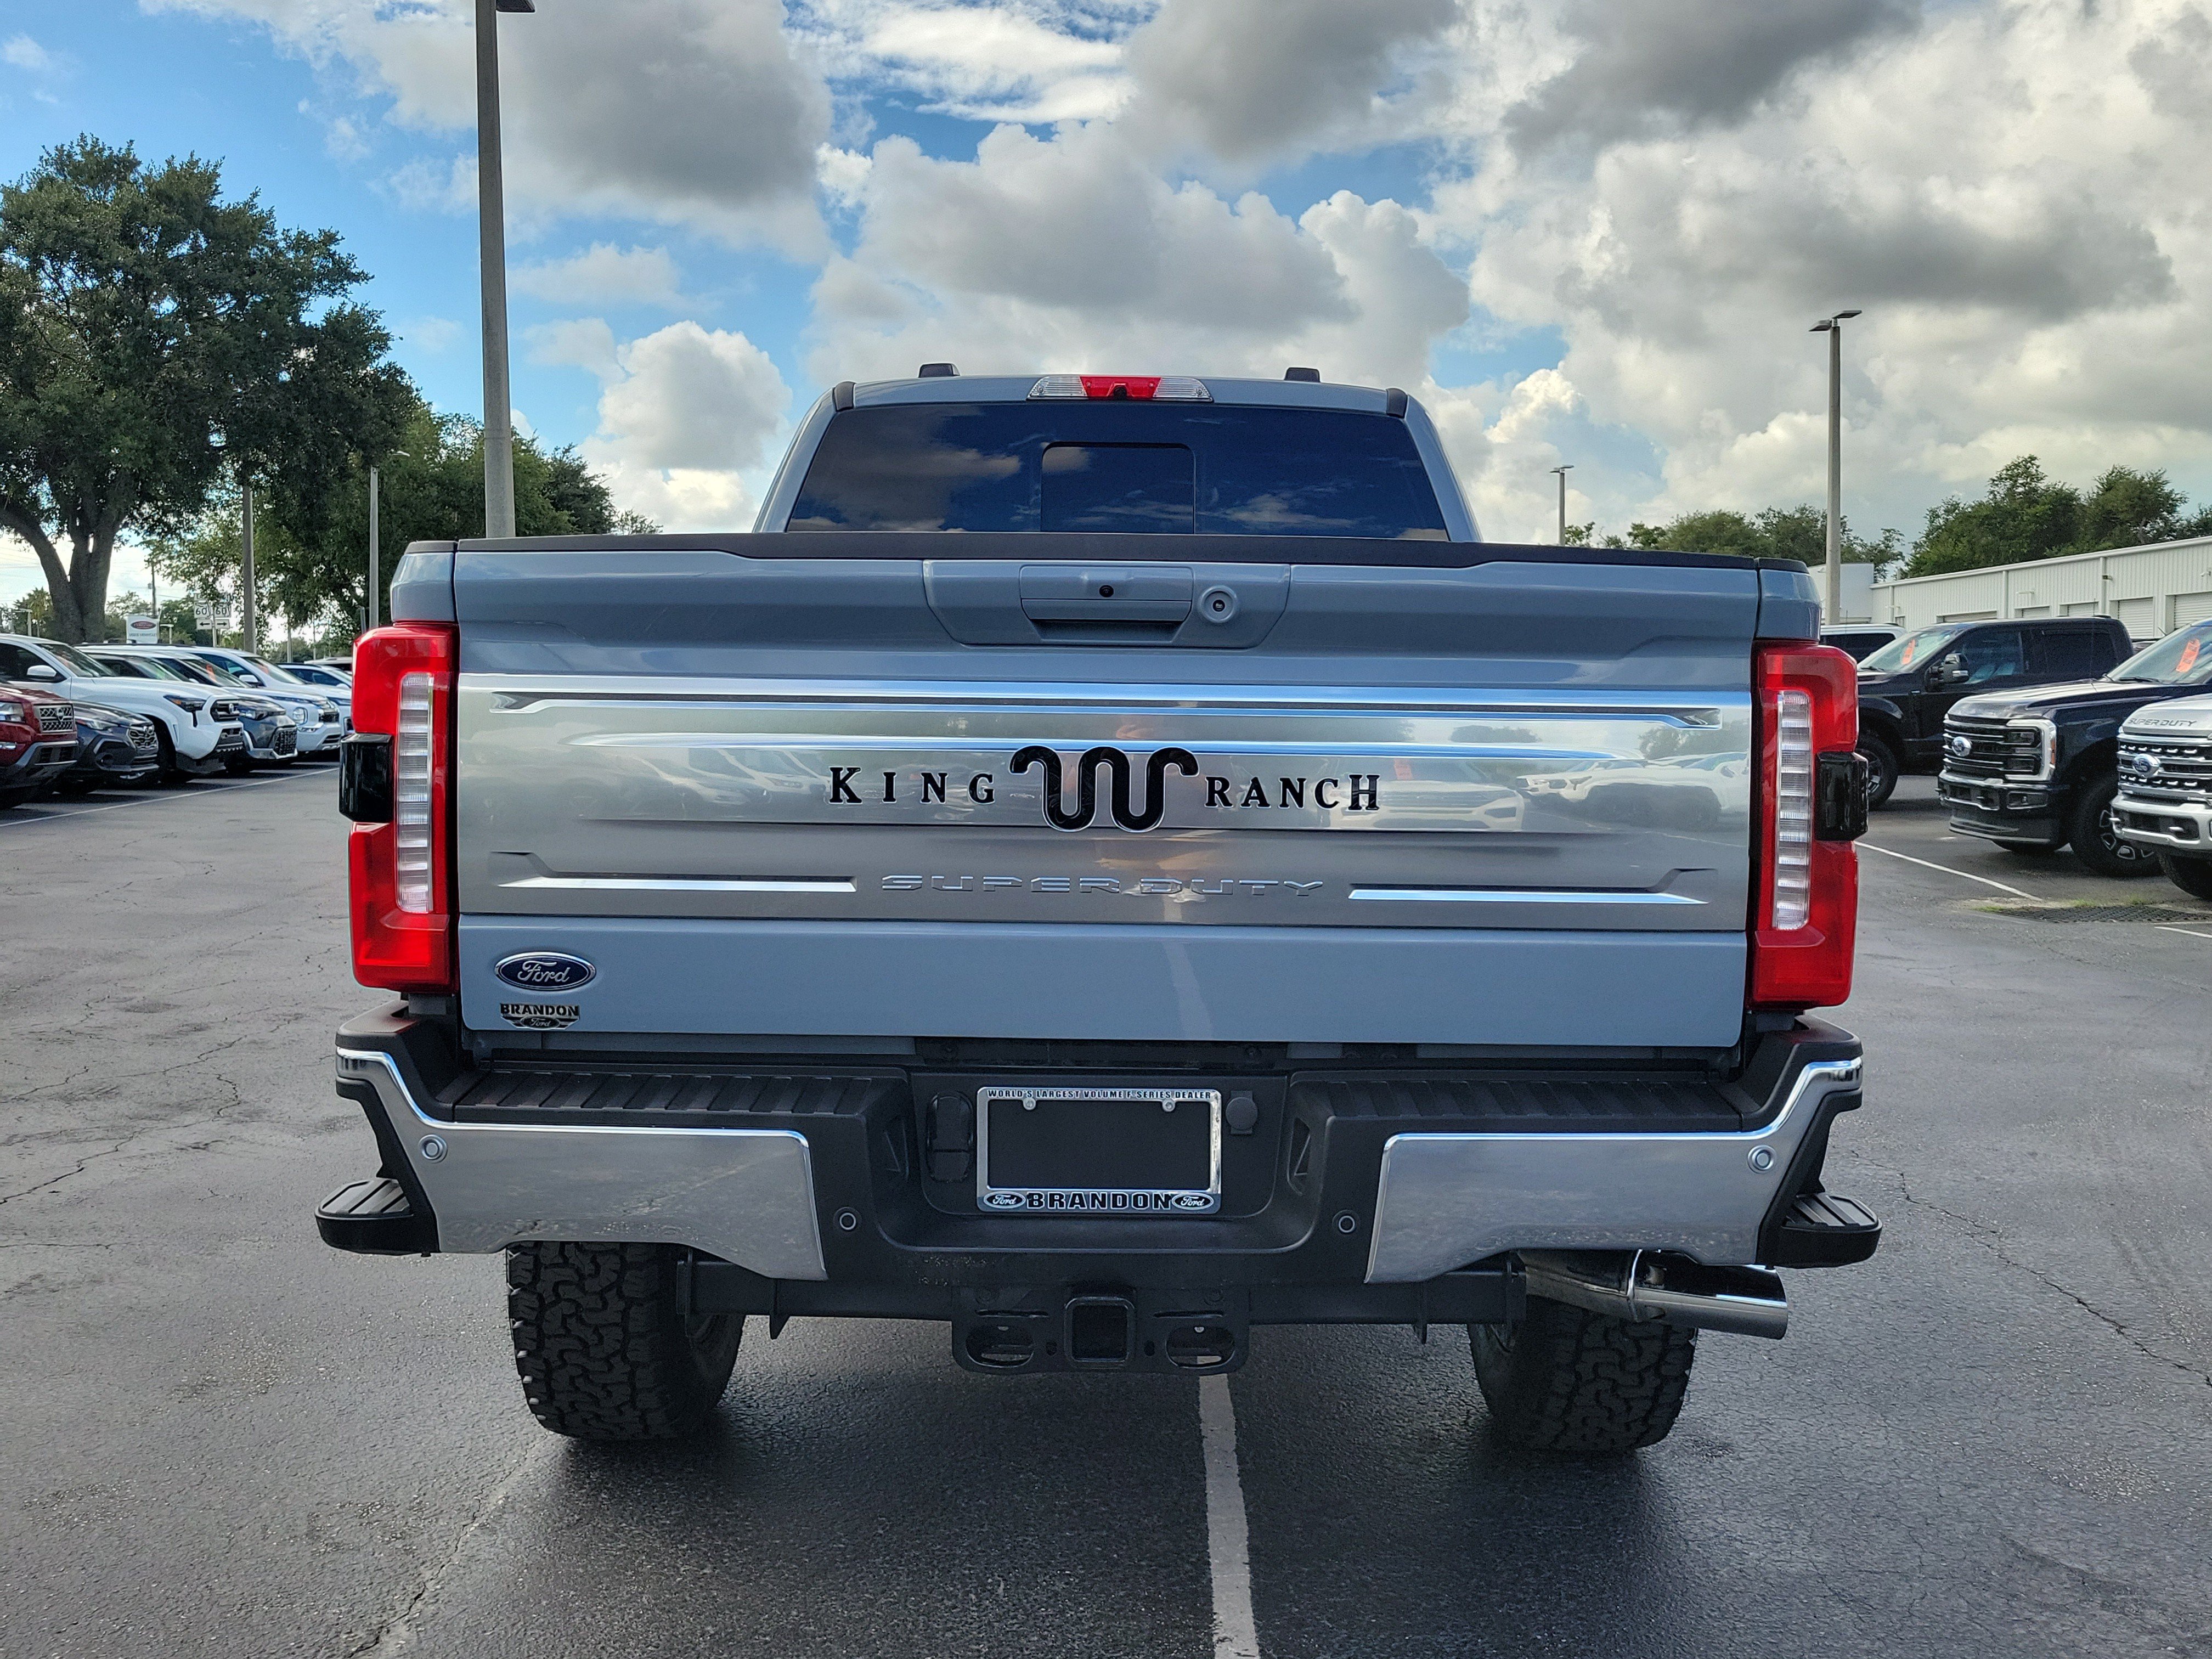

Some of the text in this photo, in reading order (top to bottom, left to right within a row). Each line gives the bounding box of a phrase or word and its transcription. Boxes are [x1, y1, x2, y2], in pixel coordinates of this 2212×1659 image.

[216, 606, 227, 615] 60
[829, 766, 1380, 811] KING RANCH
[882, 875, 1323, 896] SUPER DUTY
[517, 961, 571, 983] Ford
[500, 1004, 579, 1016] BRANDON
[530, 1018, 551, 1026] Ford
[988, 1090, 1211, 1099] WORLD'S LARGEST VOLUME F-SERIES DEALER
[992, 1192, 1205, 1209] Ford BRANDON Ford
